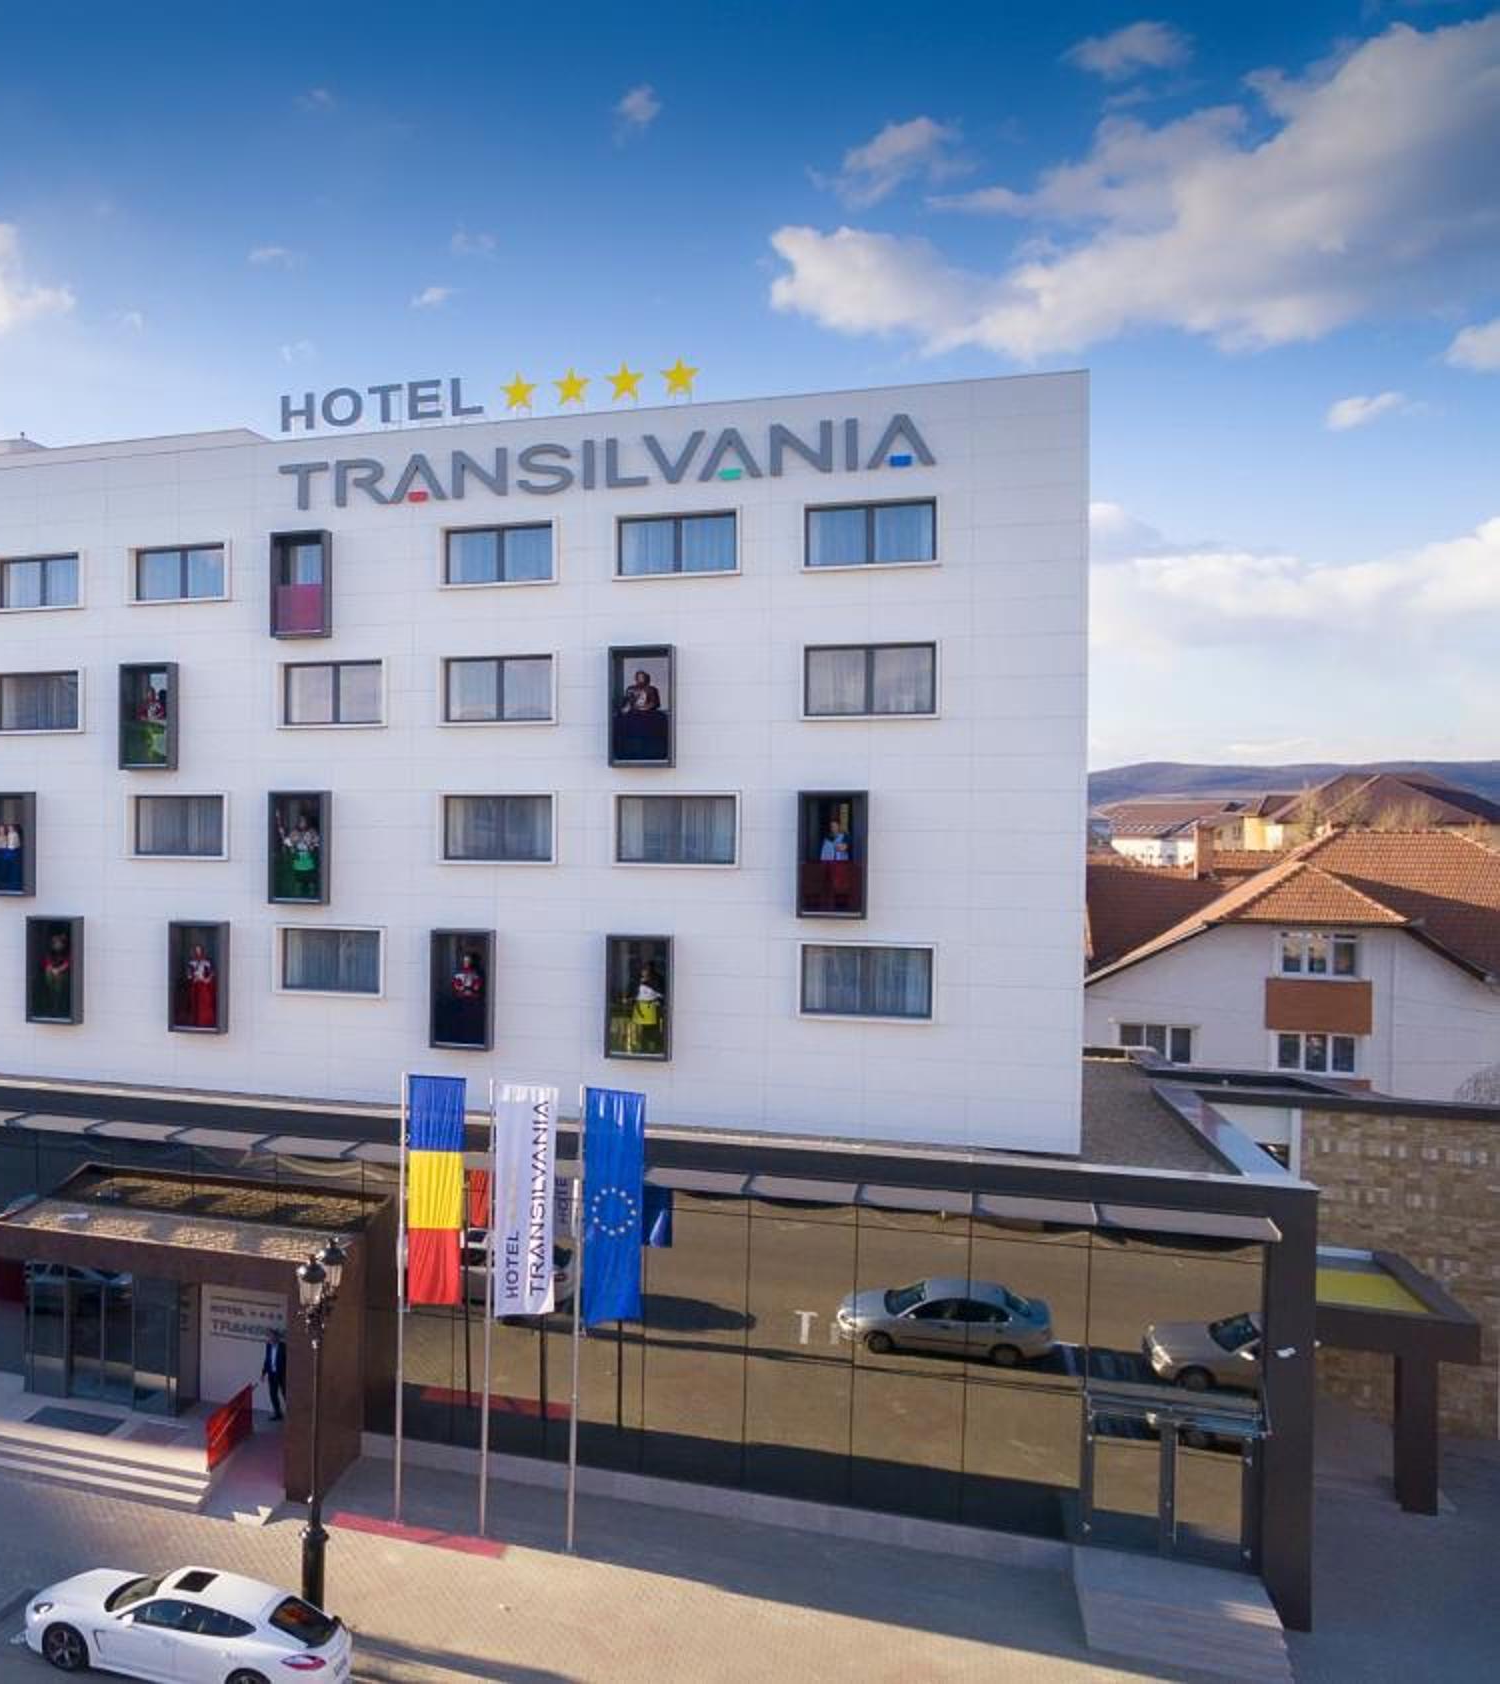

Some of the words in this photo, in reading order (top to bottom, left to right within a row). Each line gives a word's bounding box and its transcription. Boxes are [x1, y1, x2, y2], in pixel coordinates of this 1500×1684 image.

[279, 377, 484, 433] HOTEL
[278, 413, 937, 511] TRANSILVANIA
[529, 1100, 550, 1296] TRANSILVANIA
[505, 1231, 520, 1299] HOTEL
